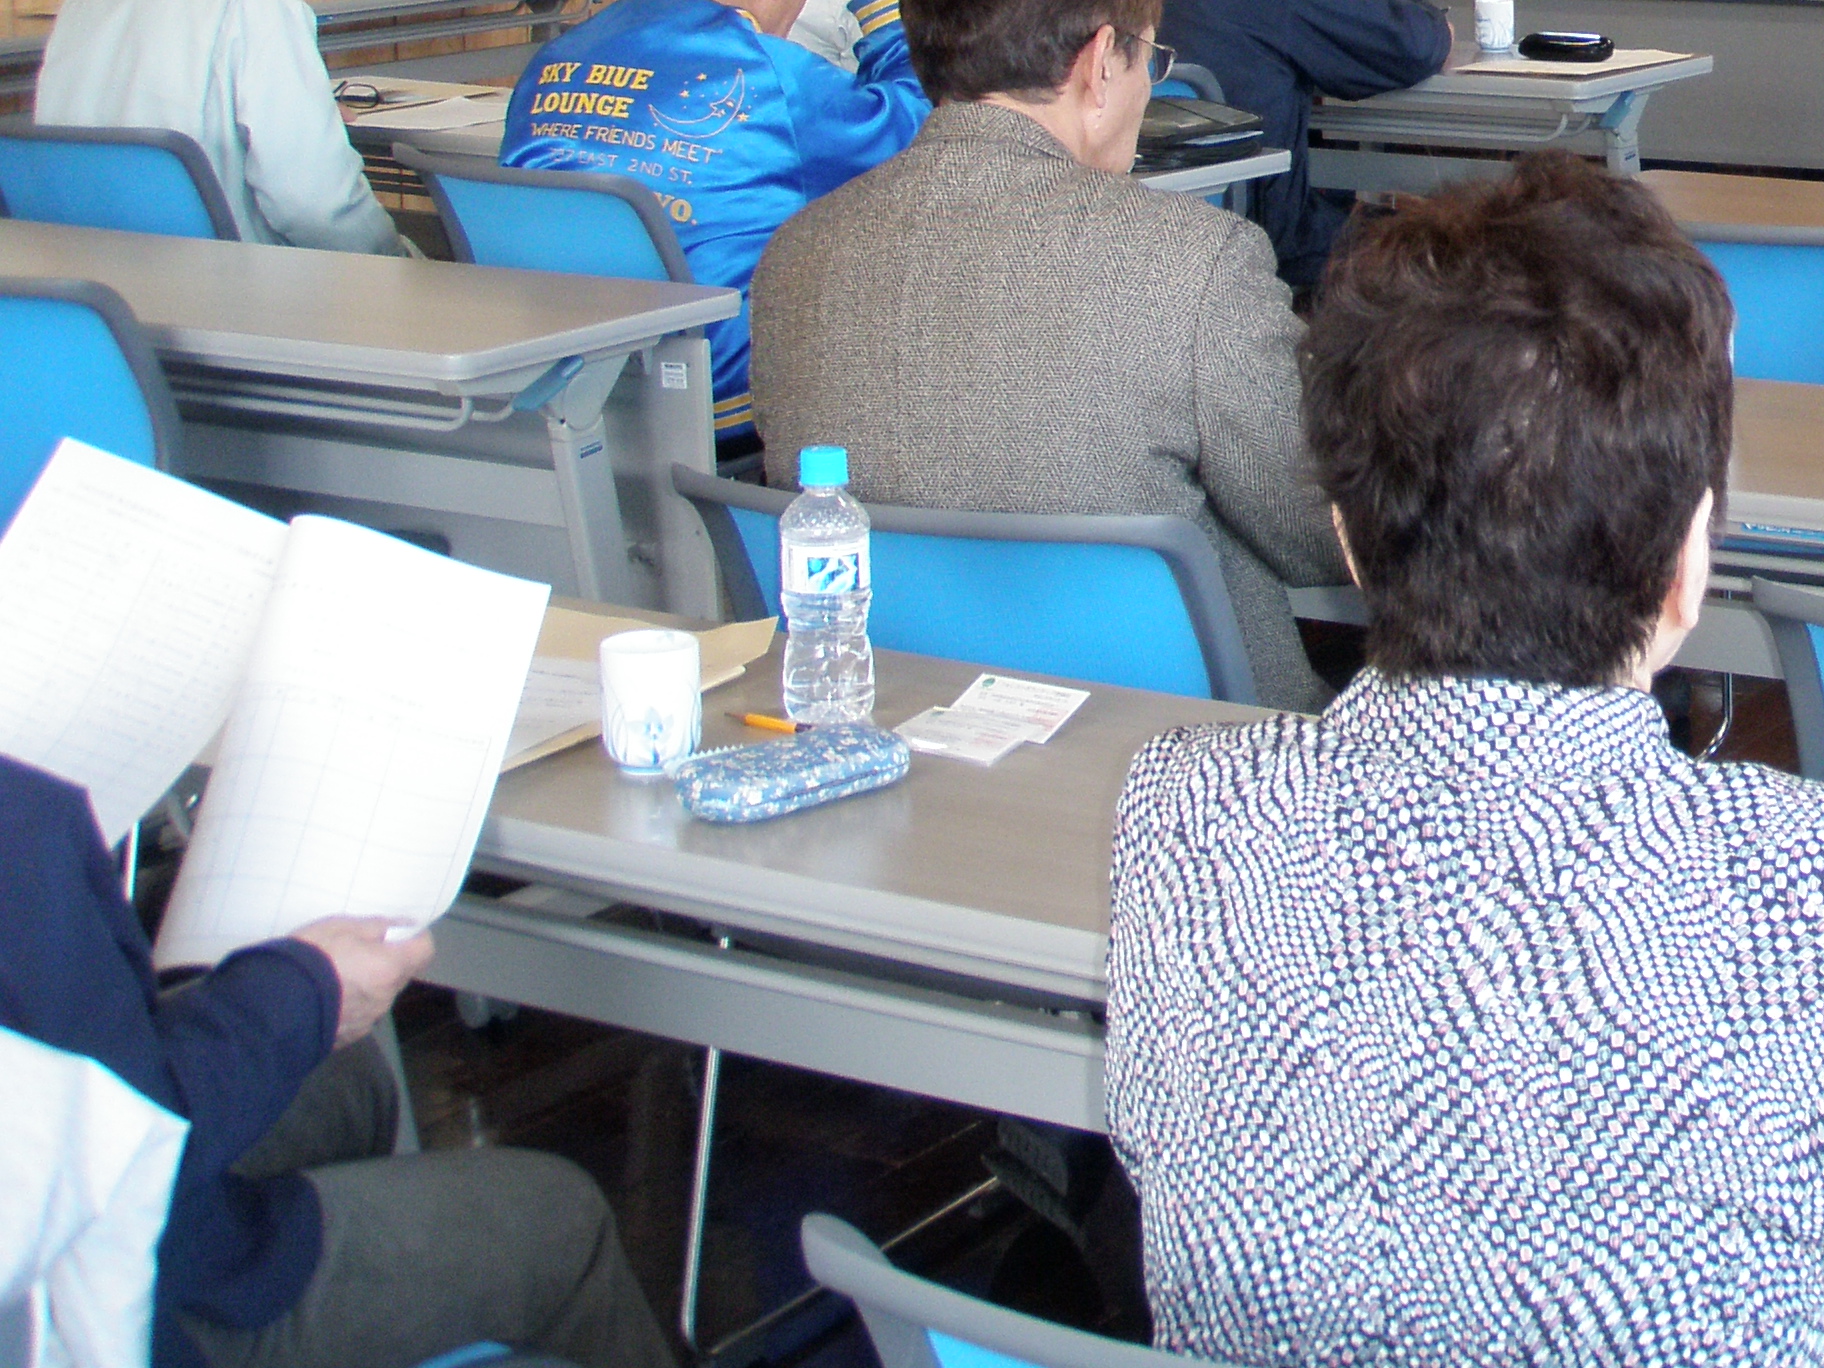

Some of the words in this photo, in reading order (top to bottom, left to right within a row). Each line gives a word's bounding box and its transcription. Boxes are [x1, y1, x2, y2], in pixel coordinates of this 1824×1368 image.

[538, 62, 582, 85] SKY
[530, 92, 635, 118] LOUNGE
[627, 158, 663, 177] 2ND
[668, 166, 693, 185] ST.
